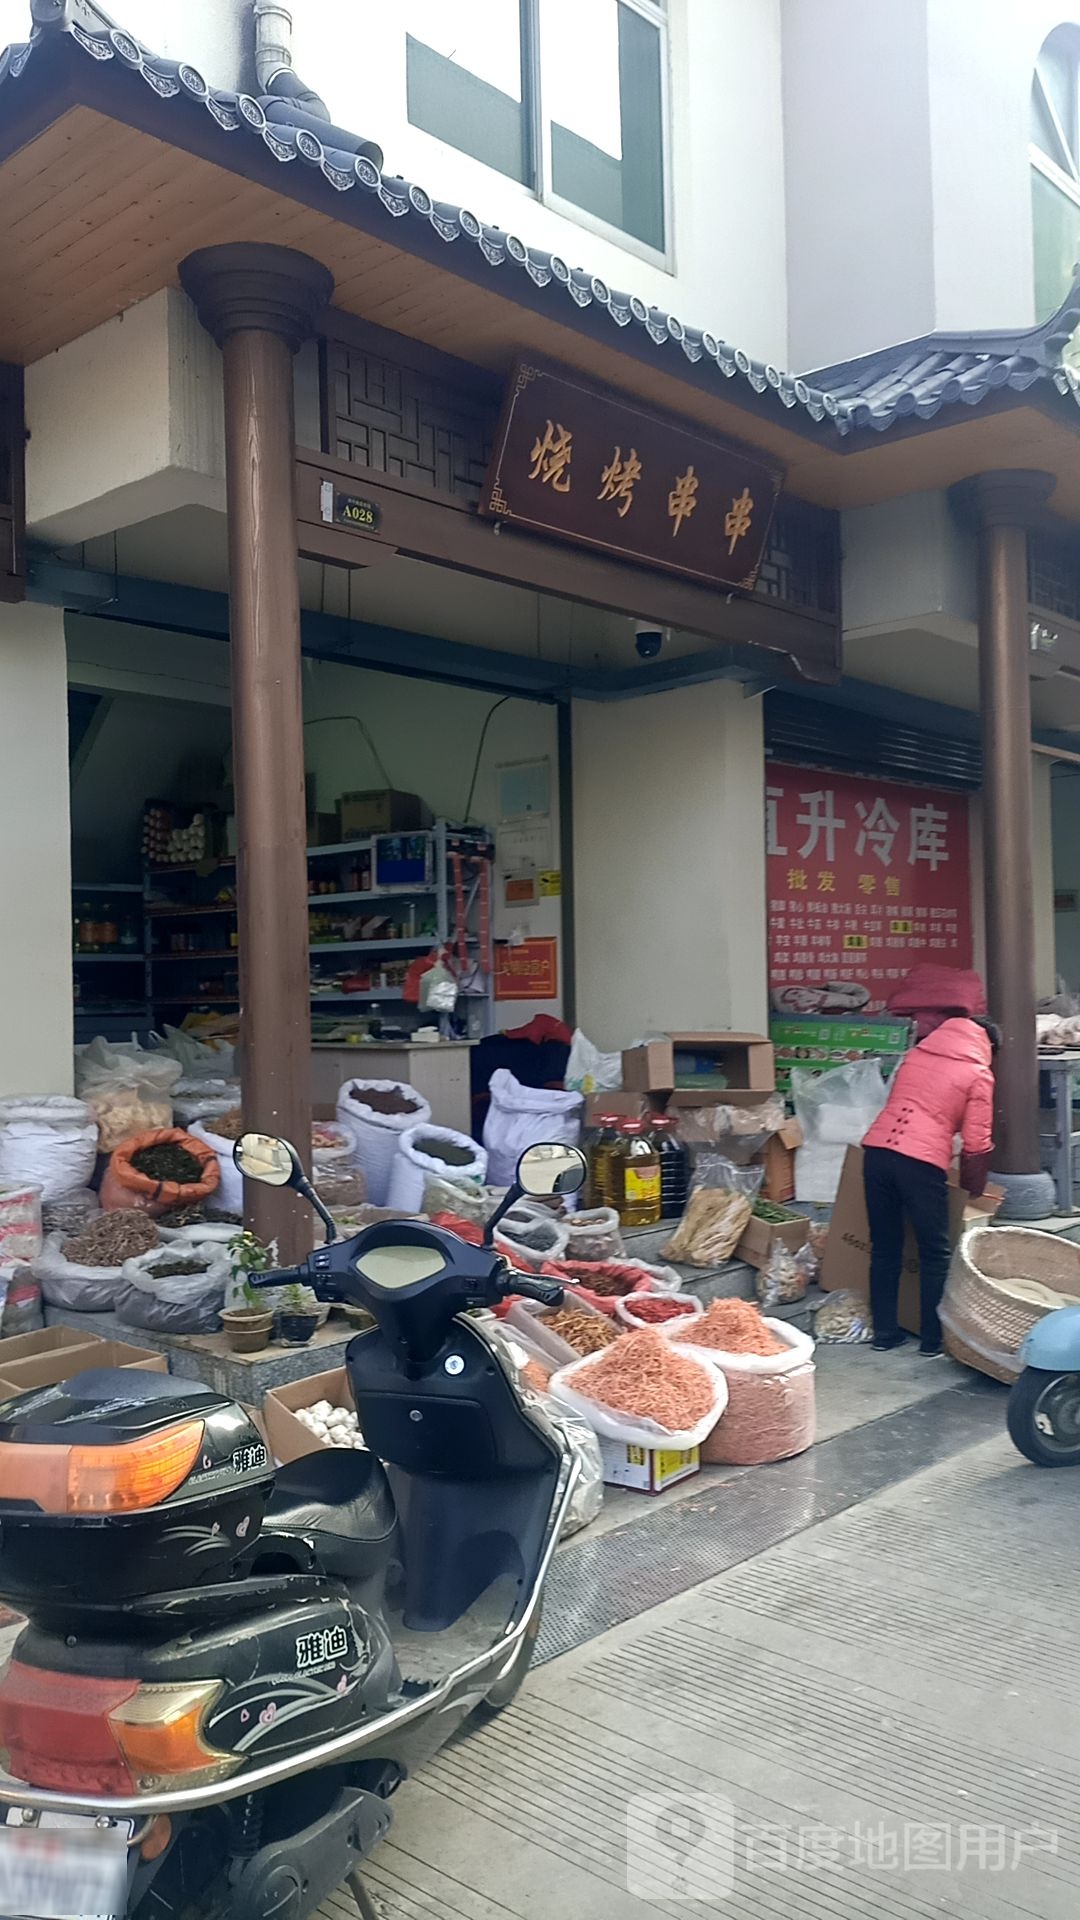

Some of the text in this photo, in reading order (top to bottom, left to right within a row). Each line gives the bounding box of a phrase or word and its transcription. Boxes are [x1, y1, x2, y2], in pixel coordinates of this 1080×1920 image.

[528, 420, 754, 556] 烧烤串串
[343, 505, 373, 524] A028
[787, 868, 902, 896] 批发 零售
[233, 1445, 267, 1474] 雅迪
[296, 1626, 348, 1668] 雅迪
